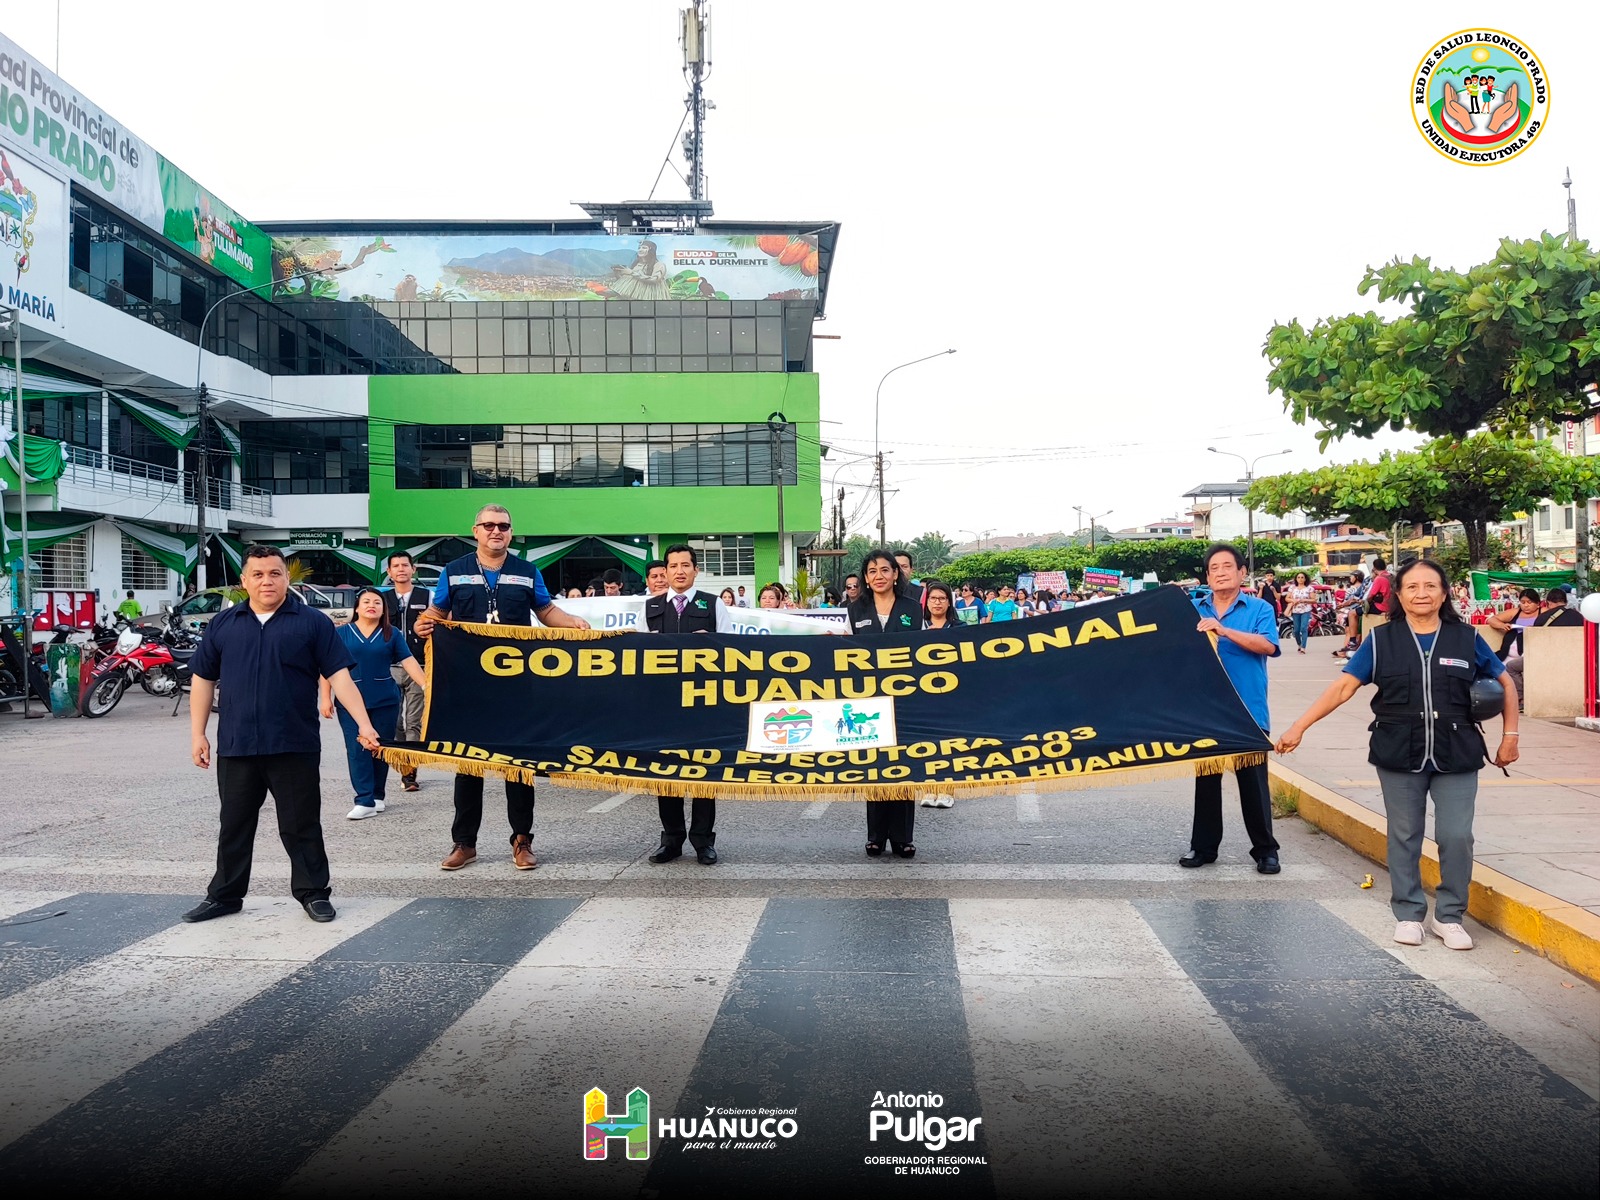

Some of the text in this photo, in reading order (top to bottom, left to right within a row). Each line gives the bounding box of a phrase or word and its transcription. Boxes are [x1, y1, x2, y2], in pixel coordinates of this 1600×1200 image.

[30, 67, 117, 155] Provincial
[120, 137, 139, 169] de
[33, 106, 116, 192] PRADO
[213, 231, 254, 271] TULUMAYOS
[673, 258, 768, 266] BELLA DURMIENTE
[8, 285, 56, 323] MARÍA
[481, 608, 1158, 677] GOBIERNO REGIONAL
[680, 671, 959, 707] HUANUCO
[567, 745, 707, 779] SALUD
[721, 765, 912, 784] LEONCIO
[925, 740, 1073, 775] PRADO
[735, 737, 1004, 768] EJECUTORA
